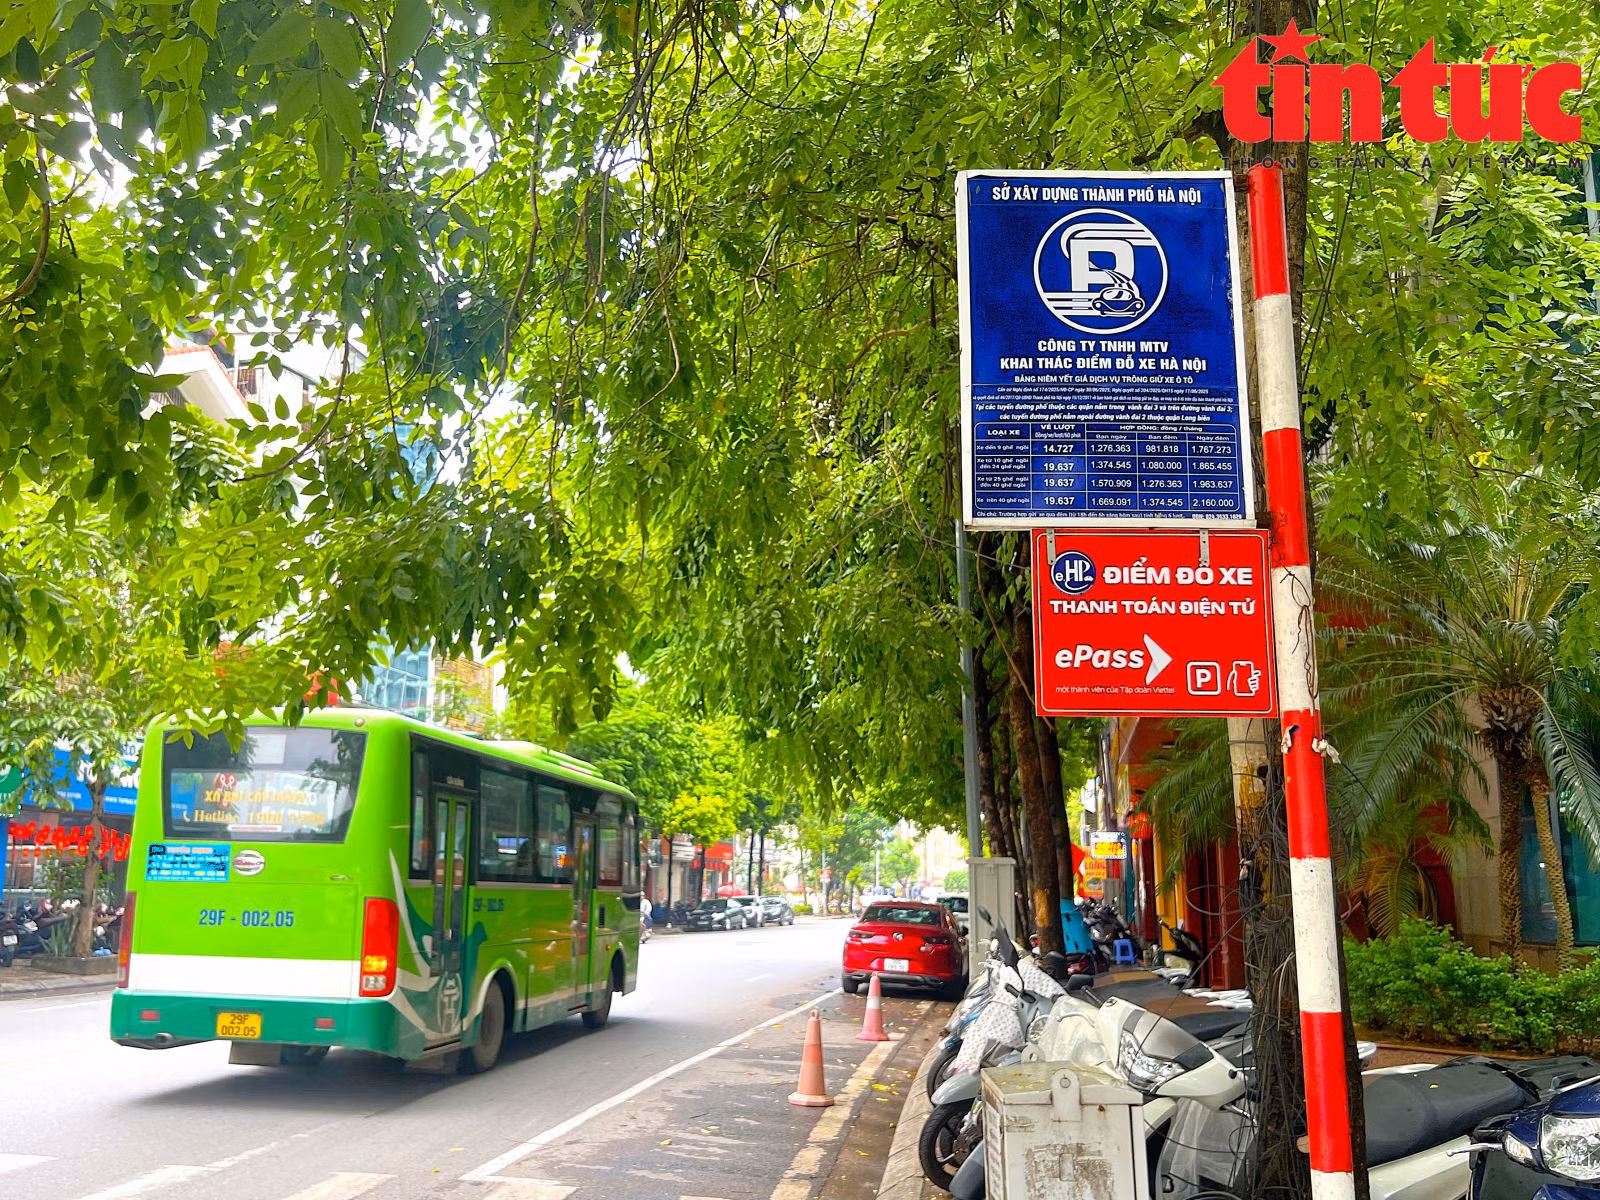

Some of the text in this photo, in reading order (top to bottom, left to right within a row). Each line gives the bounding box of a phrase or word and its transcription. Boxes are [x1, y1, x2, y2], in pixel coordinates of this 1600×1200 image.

[992, 181, 1202, 206] SỞ XÂY DỰNG THÀNH PHỐ HÀ NỘI
[1037, 338, 1169, 353] CÔNG TY TNHH MTV
[1000, 353, 1207, 373] KHAI THÁC ĐIỂM ĐỖ XE HÀ NỘI
[1014, 373, 1194, 385] BẢNG NIÊM YẾT GIÁ DỊCH VỤ TRÔNG GIỮ XE Ô TÔ
[997, 403, 1014, 411] tuyến
[1108, 404, 1126, 412] trong
[1180, 405, 1201, 413] đường
[1011, 412, 1029, 421] tuyến
[1029, 413, 1050, 421] đường
[1094, 413, 1115, 421] đường
[987, 429, 1007, 437] LOẠI
[1043, 444, 1074, 453] 14.727
[1090, 444, 1131, 453] 1.276.363
[1145, 444, 1179, 453] 981.818
[1191, 445, 1232, 454] 1.767.273
[1043, 462, 1075, 471] 19.637
[1091, 461, 1132, 469] 1.374.545
[1141, 461, 1182, 470] 1.080.000
[1192, 462, 1233, 471] 1.865.455
[1043, 479, 1075, 487] 19.637
[1090, 479, 1132, 488] 1.570.909
[1142, 480, 1183, 488] 1.276.363
[1192, 480, 1233, 489] 1.963.637
[1044, 497, 1075, 505] 19.637
[1091, 497, 1132, 506] 1.669.091
[1142, 498, 1183, 507] 1.374.545
[1192, 498, 1234, 507] 2.160.000
[1103, 556, 1171, 585] ĐIỂM
[1218, 566, 1253, 585] XE
[1050, 596, 1256, 618] THANH TOÁN ĐIỆN TỬ
[1055, 645, 1145, 669] ePass
[1195, 669, 1212, 688] P
[1119, 686, 1133, 694] Tập
[1134, 686, 1151, 694] đoàn
[199, 909, 226, 926] 29F
[242, 910, 294, 927] 002.05
[230, 1014, 249, 1025] 29F
[221, 1025, 257, 1037] 002.05
